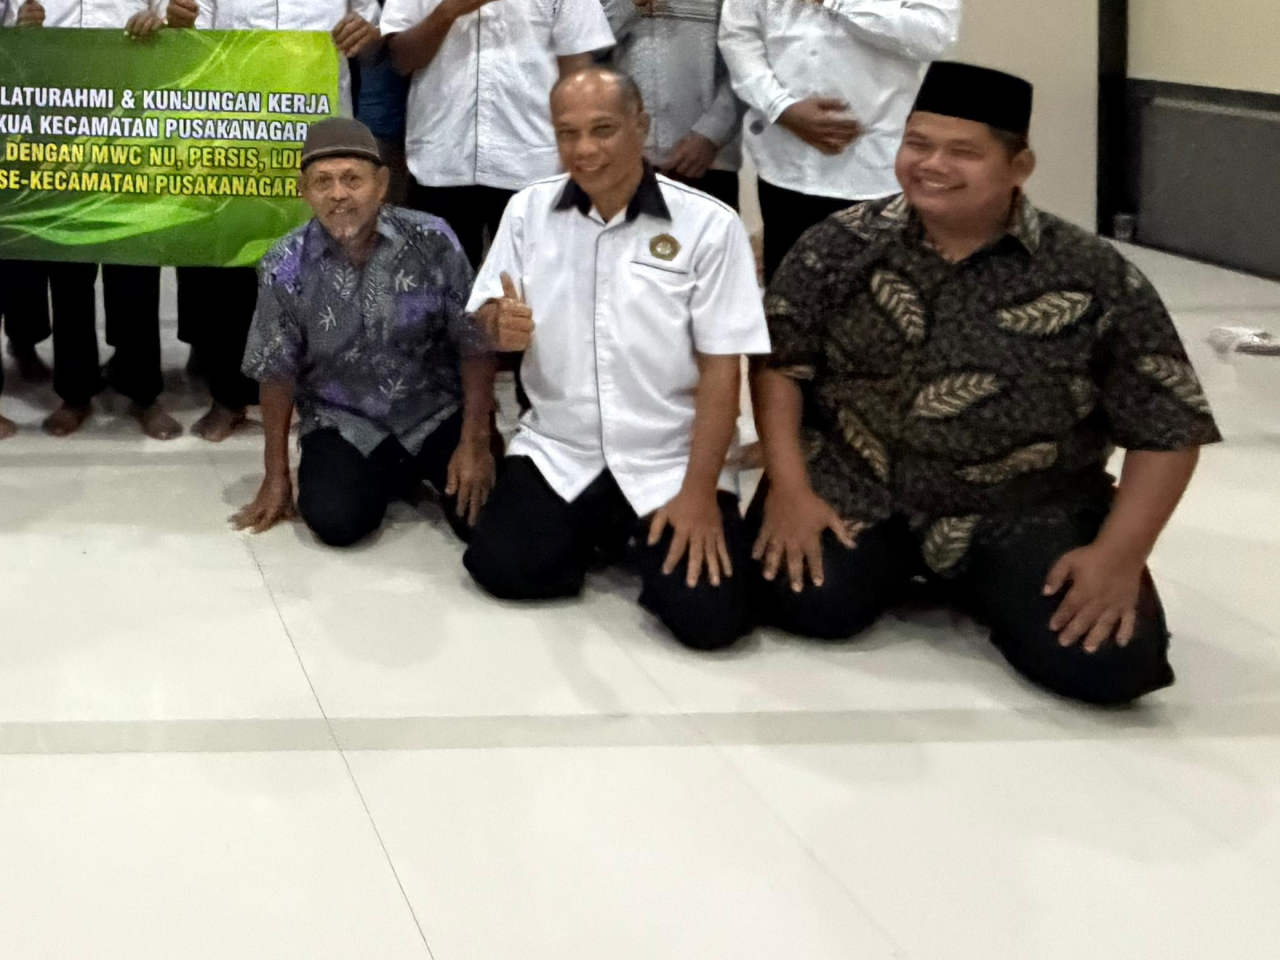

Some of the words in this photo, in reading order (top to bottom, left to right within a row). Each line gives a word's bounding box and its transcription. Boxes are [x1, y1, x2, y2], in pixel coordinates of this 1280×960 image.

[121, 88, 136, 109] &
[143, 89, 260, 112] KUNJUNGAN
[268, 93, 330, 114] KERJA
[40, 115, 158, 137] KECAMATAN
[165, 118, 310, 142] PUSAKANAGAR
[6, 142, 84, 162] DENGAN
[91, 144, 142, 165] MWC
[149, 146, 183, 170] NU,
[188, 147, 265, 172] PERSIS,
[156, 174, 302, 196] PUSAKANAGAR
